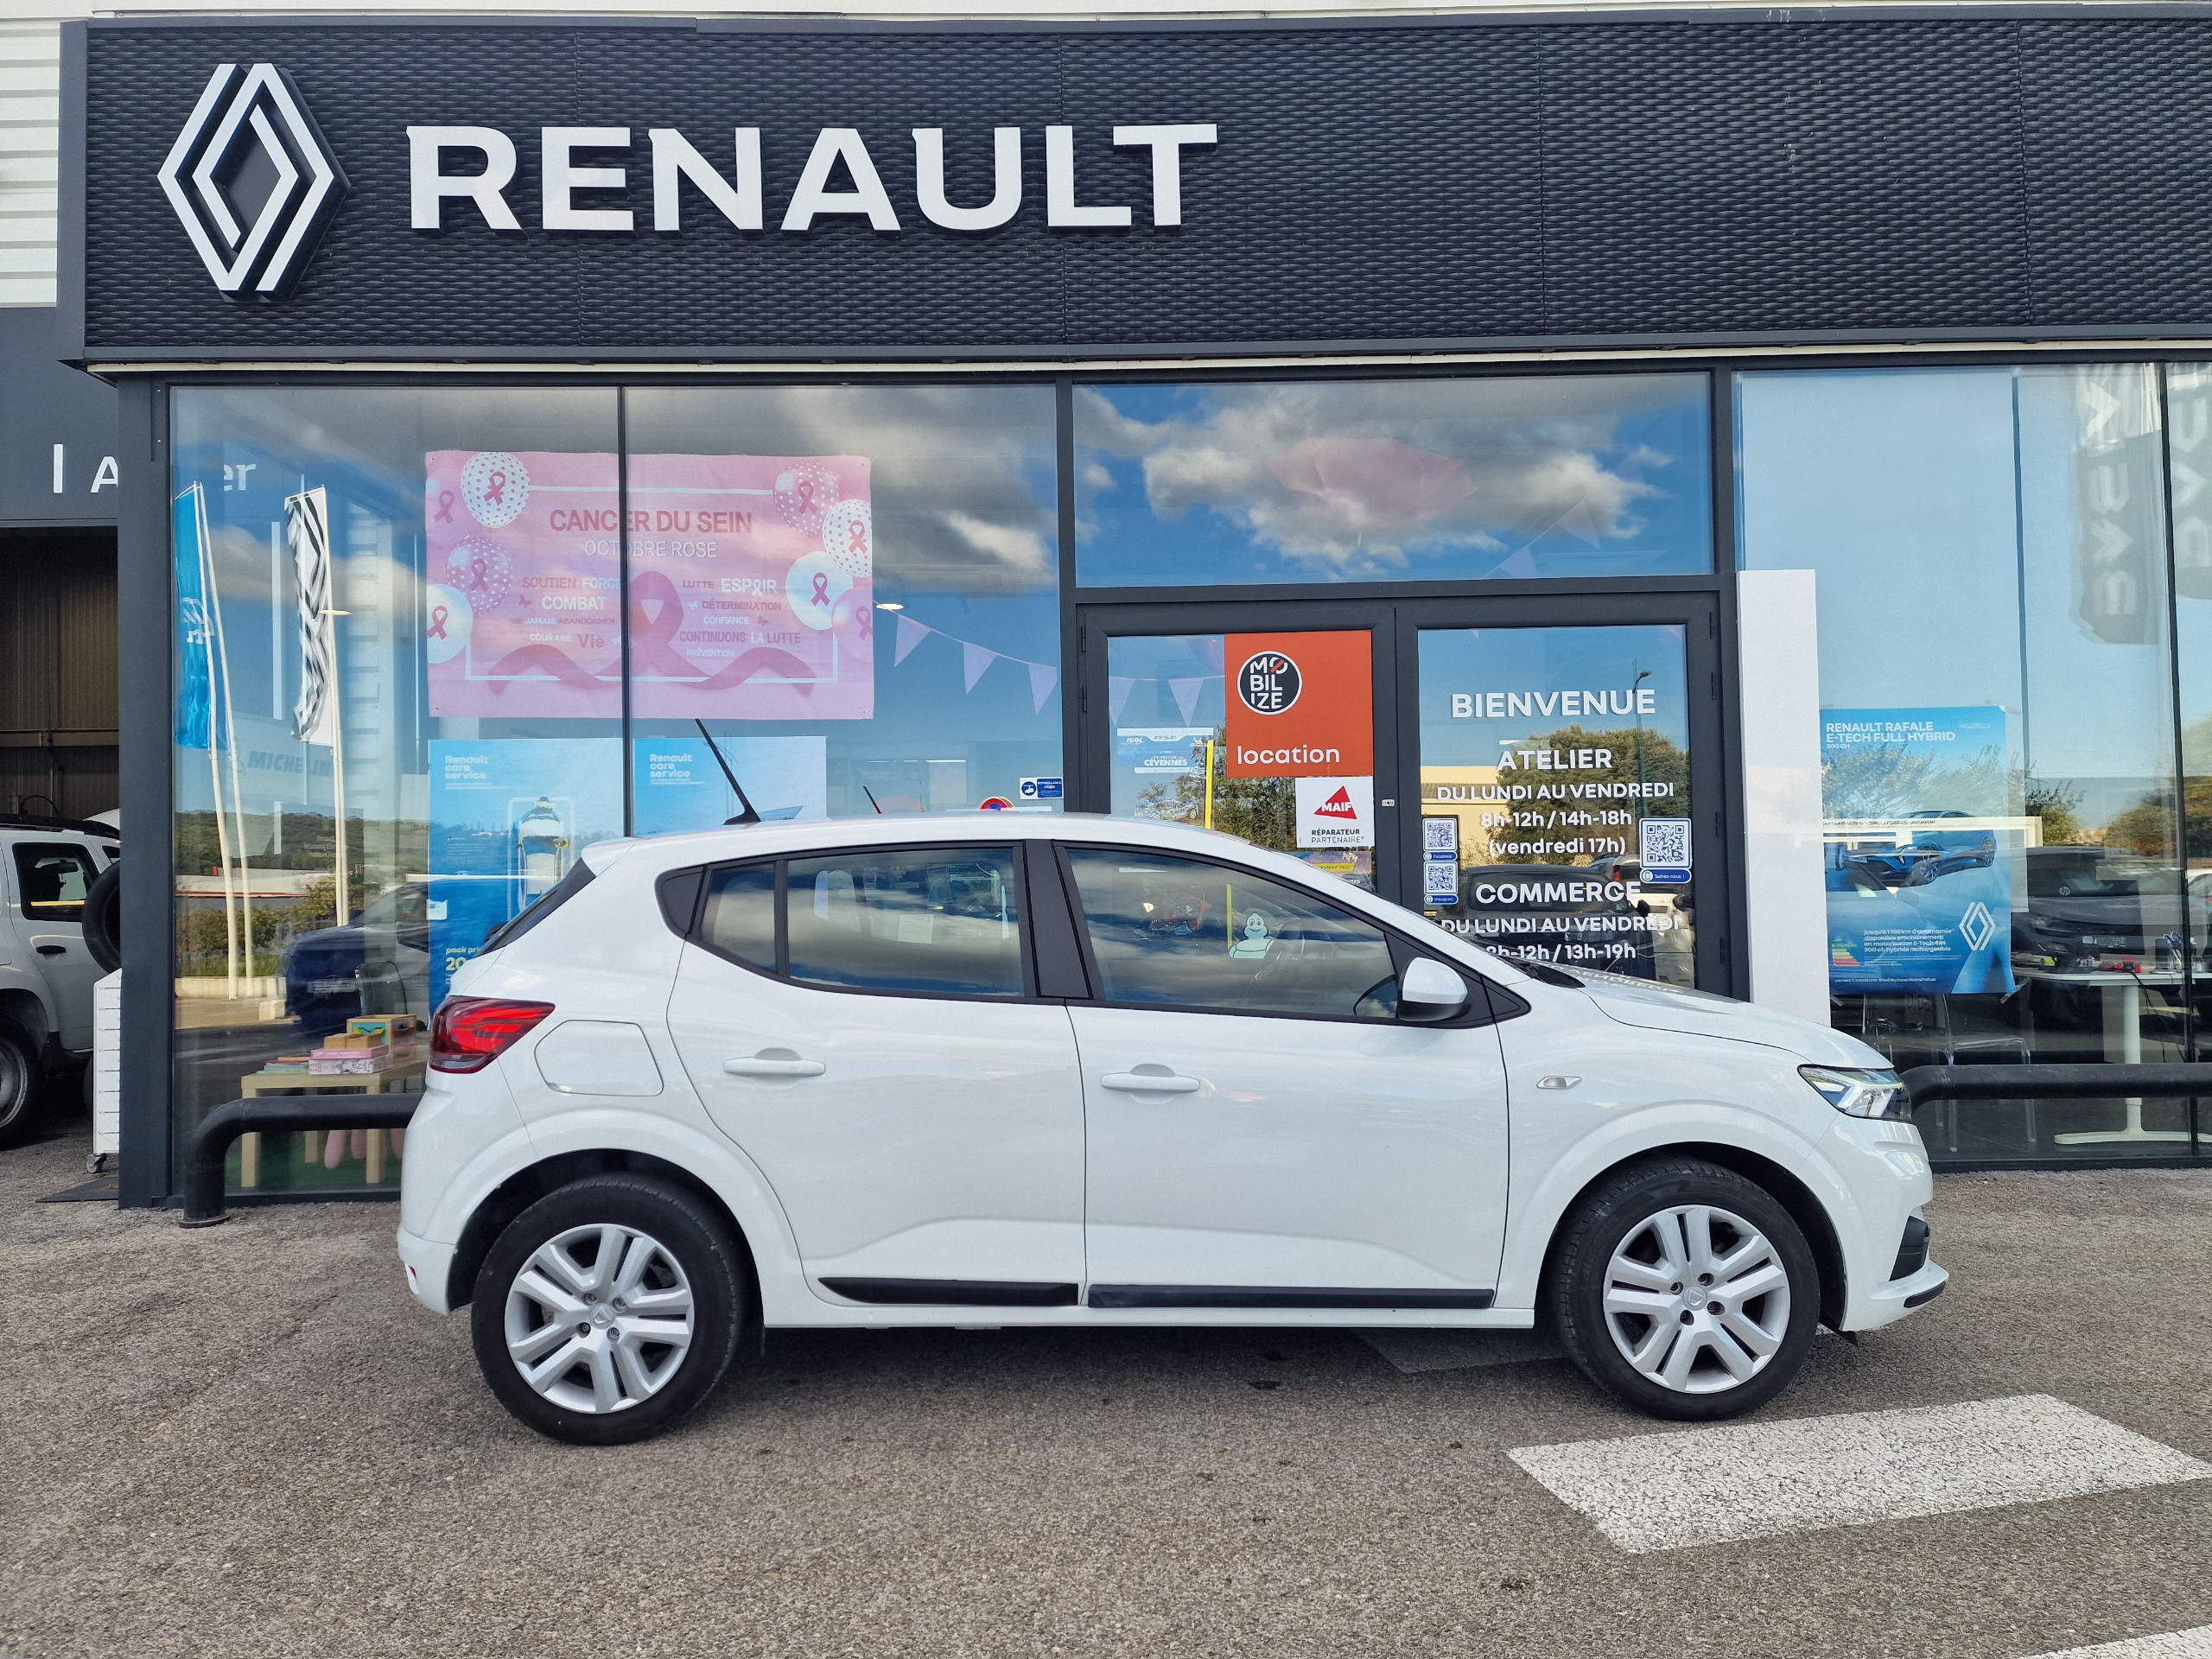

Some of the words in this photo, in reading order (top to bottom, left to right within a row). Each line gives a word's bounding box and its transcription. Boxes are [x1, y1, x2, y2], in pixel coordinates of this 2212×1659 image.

[406, 124, 1218, 232] RENAULT
[550, 509, 651, 532] CANCER
[657, 510, 690, 533] DU
[696, 511, 753, 534] SEIN
[671, 541, 718, 558] ROSE
[523, 576, 576, 588] SOUTIEN
[582, 577, 621, 589] FORCE
[683, 580, 715, 588] LUTTE
[542, 596, 607, 610] COMBAT
[702, 599, 782, 611] DÉTERMINATION
[703, 616, 750, 625] CONFIANCE
[530, 633, 572, 642] COURAGE
[577, 633, 605, 648] Vie
[679, 631, 747, 643] CONTINUONS
[751, 632, 764, 644] LA
[767, 632, 801, 644] LUTTE
[687, 648, 734, 658] PRÉVENTION
[1452, 689, 1656, 718] BIENVENUE
[1826, 722, 1883, 733] RENAULT
[1885, 721, 1934, 732] RAFALE
[1826, 733, 1872, 743] E-TECH
[1873, 732, 1905, 742] FULL
[1908, 731, 1956, 741] HYBRID
[445, 755, 488, 764] Renault
[650, 753, 692, 762] Renault
[1237, 744, 1340, 765] location
[1497, 748, 1612, 771] ATELIER
[246, 750, 334, 777] MICHEIN
[1144, 758, 1187, 766] CÉVENNES
[445, 771, 486, 779] service
[1437, 786, 1465, 801] DU
[1471, 785, 1532, 800] LUNDI
[1535, 784, 1566, 799] AU
[1568, 782, 1675, 798] VENDREDI
[1321, 802, 1352, 812] MAIF
[1480, 810, 1543, 828] 8h-12h
[1547, 810, 1556, 830] /
[1559, 809, 1632, 826] 14h-18h
[1311, 827, 1360, 836] RÉPARATEUR
[1488, 837, 1584, 857] (vendredi
[1587, 836, 1626, 856] 17h)
[1475, 881, 1642, 904] COMMERCE
[1441, 919, 1469, 934] DU
[1474, 918, 1536, 933] LUNDI
[1541, 917, 1570, 932] AU
[1573, 915, 1679, 931] VENDREDI
[445, 946, 467, 955] pack
[1565, 943, 1637, 960] 13h-19h
